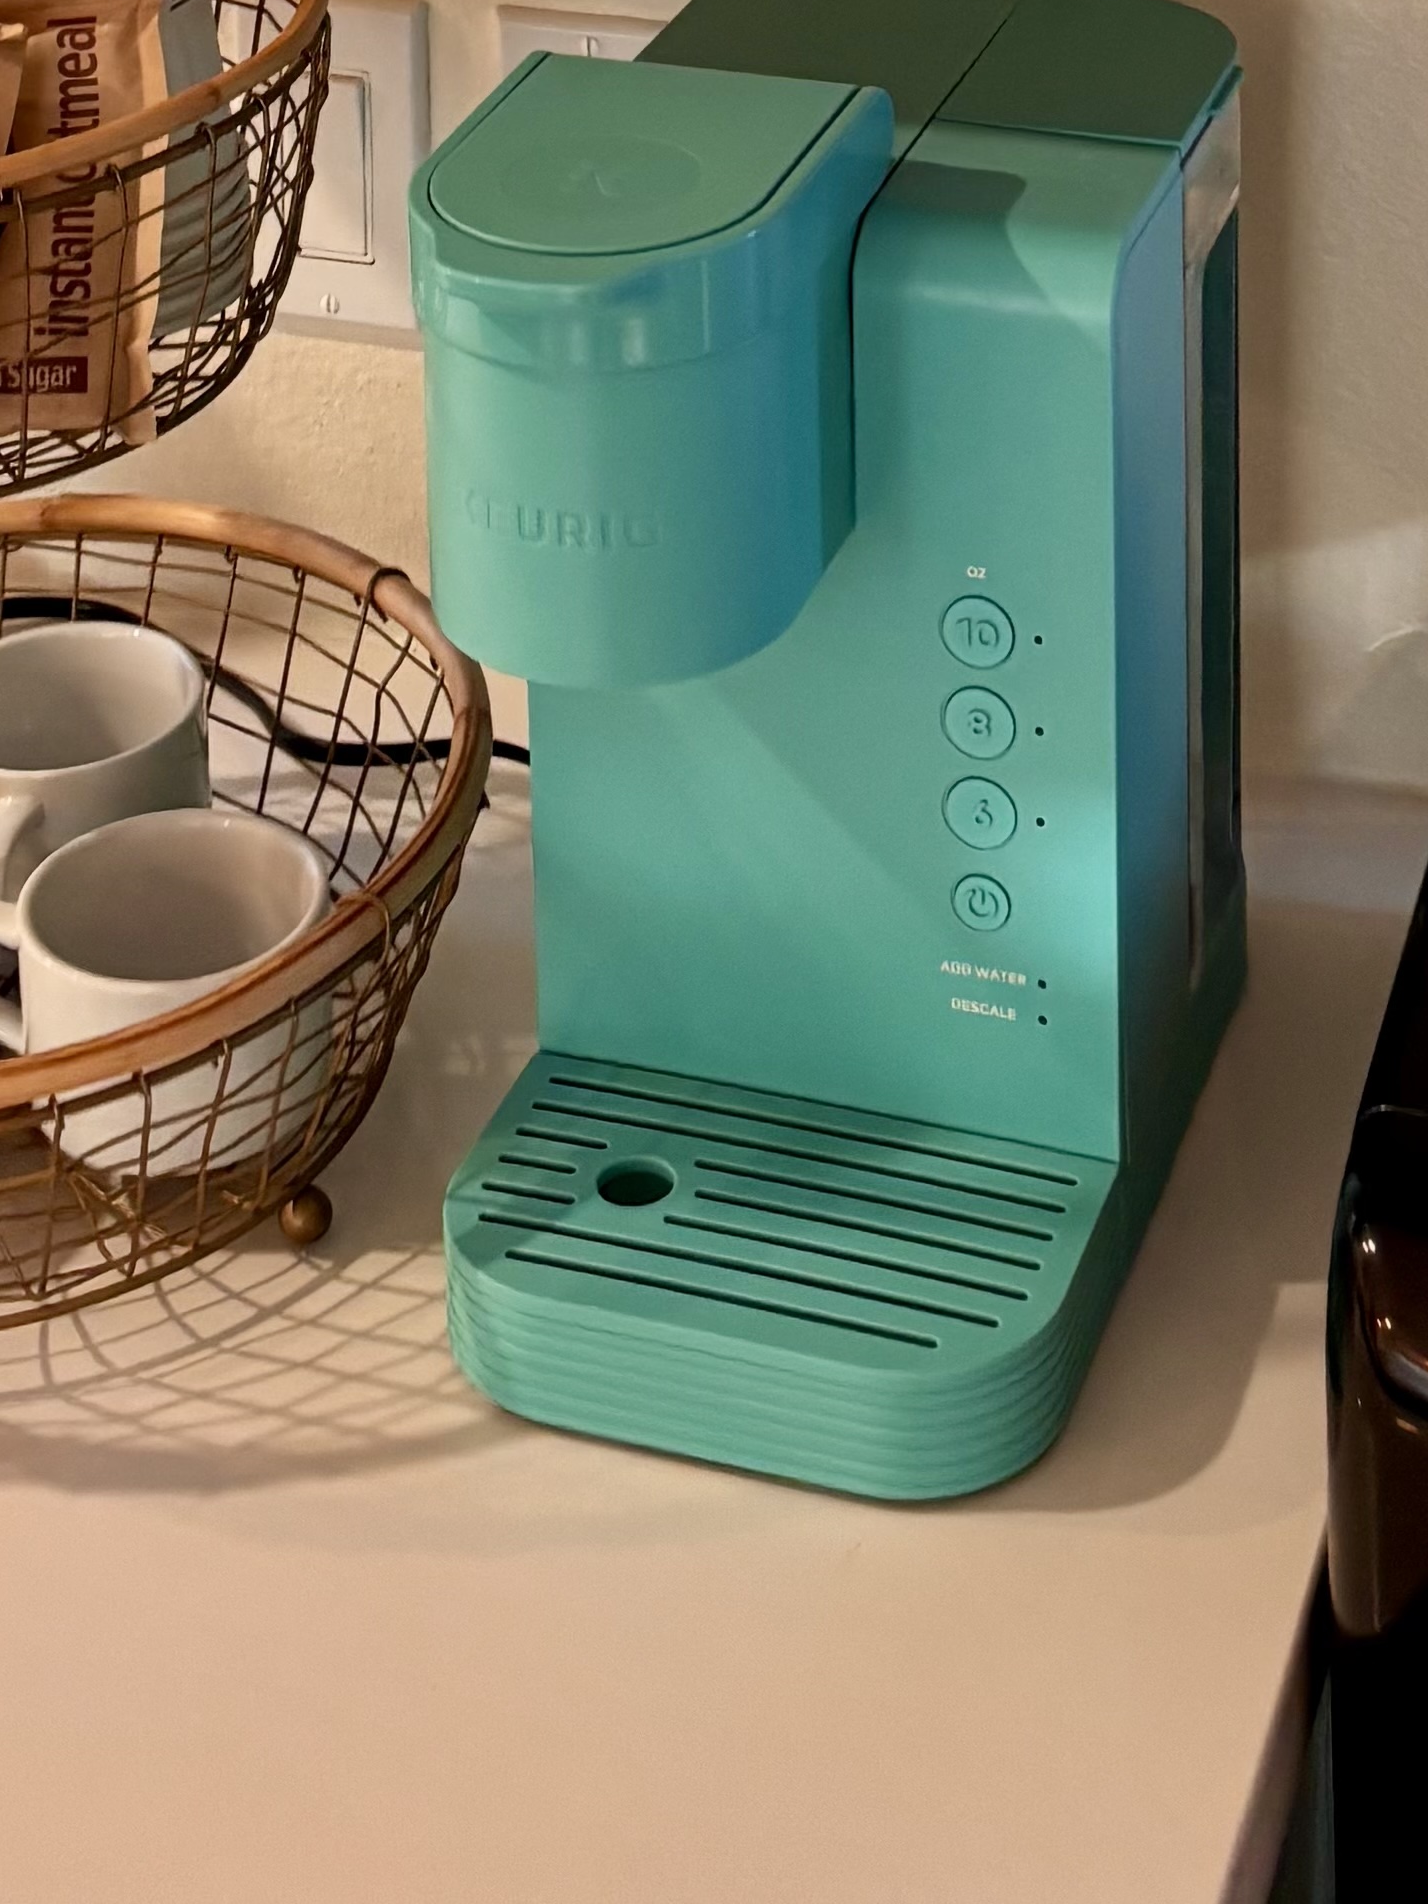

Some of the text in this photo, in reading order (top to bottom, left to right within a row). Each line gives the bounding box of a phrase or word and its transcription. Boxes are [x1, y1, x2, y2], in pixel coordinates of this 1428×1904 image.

[47, 15, 101, 183] otmeal
[464, 488, 661, 549] URIG
[966, 565, 987, 579] OZ
[955, 617, 1001, 648] 10
[968, 708, 992, 740] 8
[940, 960, 1027, 986] ADD WATER
[951, 997, 1016, 1021] DESCALE
